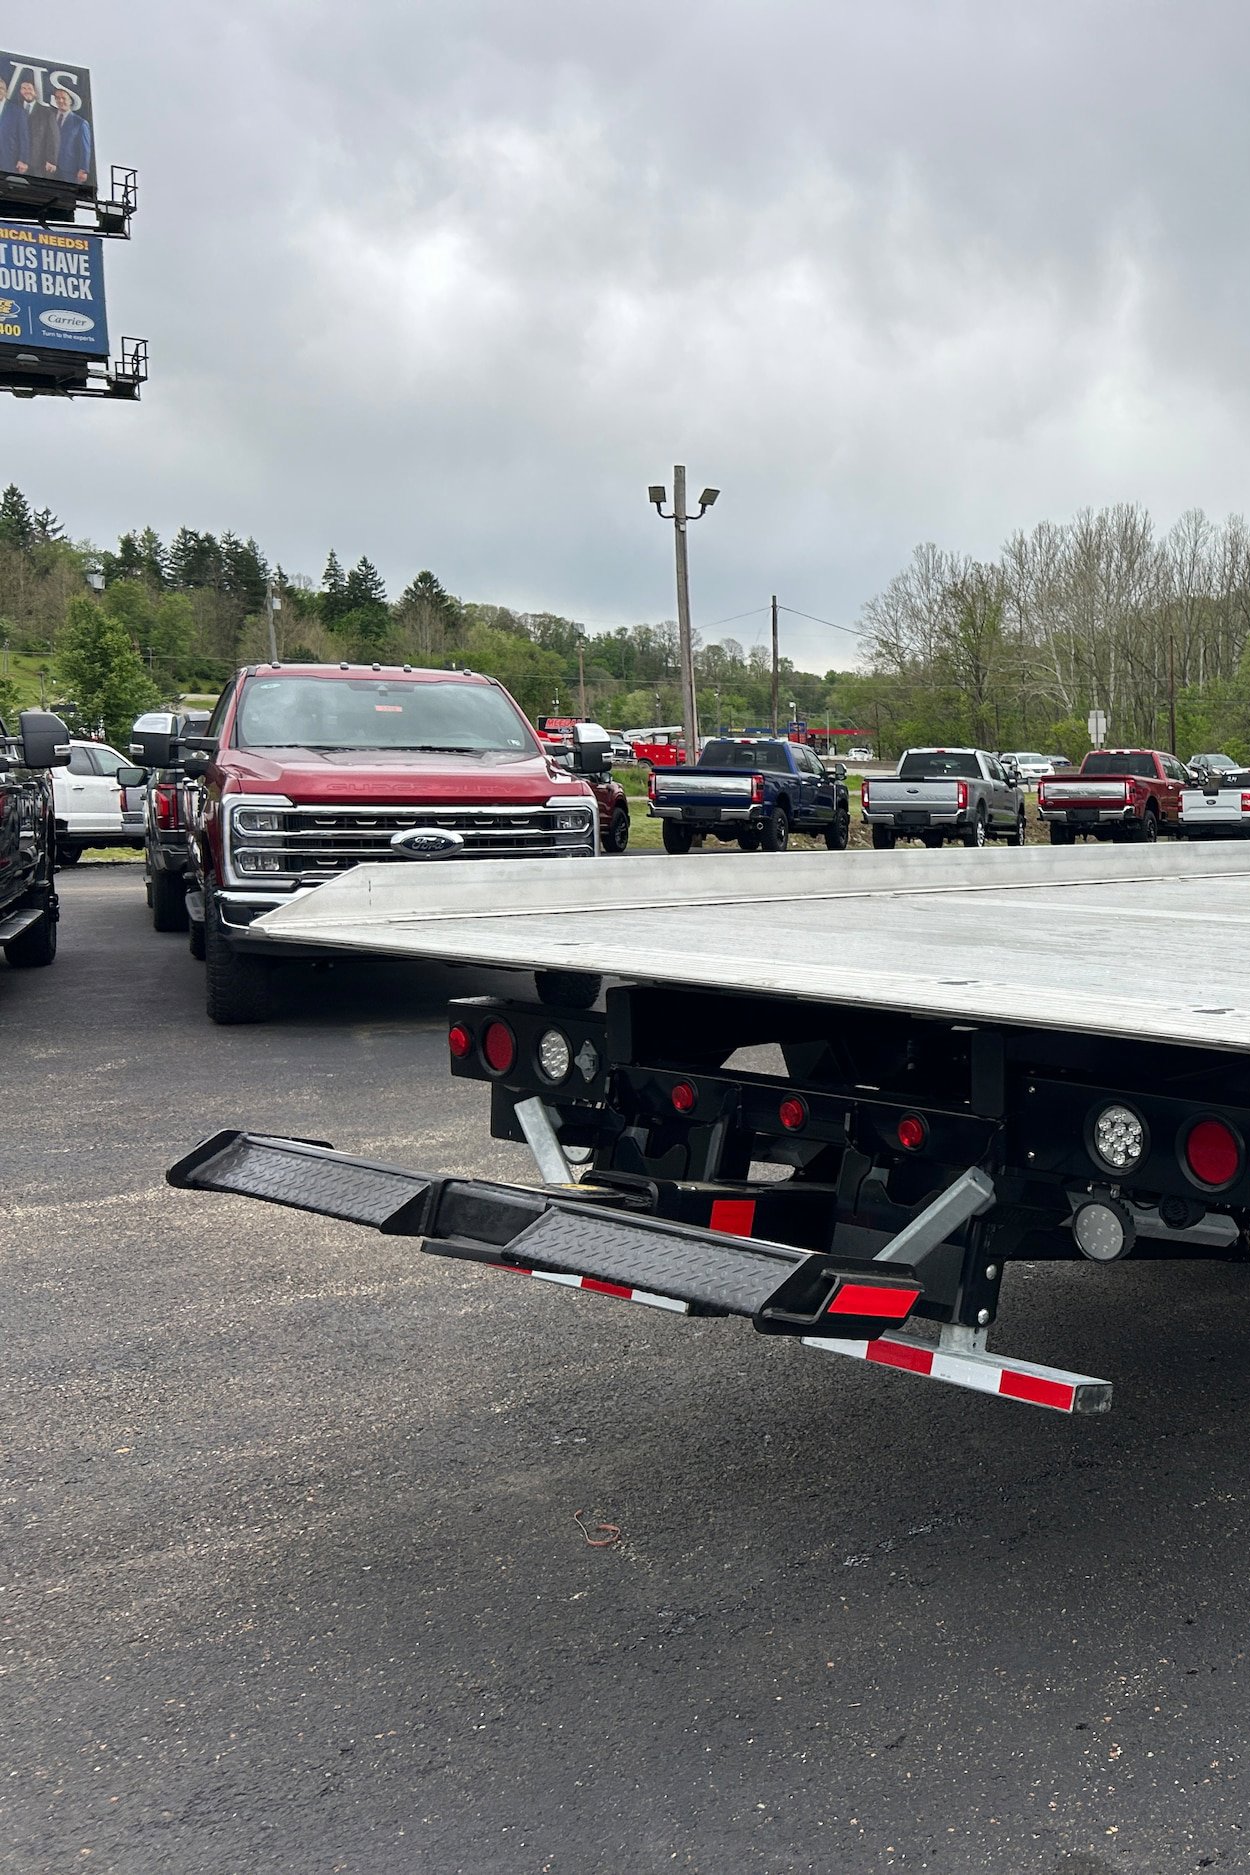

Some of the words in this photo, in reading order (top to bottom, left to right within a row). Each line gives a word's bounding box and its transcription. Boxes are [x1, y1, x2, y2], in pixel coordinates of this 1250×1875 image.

[38, 234, 89, 250] NEEDS!
[12, 245, 38, 269] US
[41, 249, 90, 276] HAVE
[0, 267, 38, 293] OUR
[41, 273, 93, 300] BACK
[47, 314, 87, 327] Carrier
[326, 783, 434, 793] SUPER
[411, 837, 446, 850] Ford
